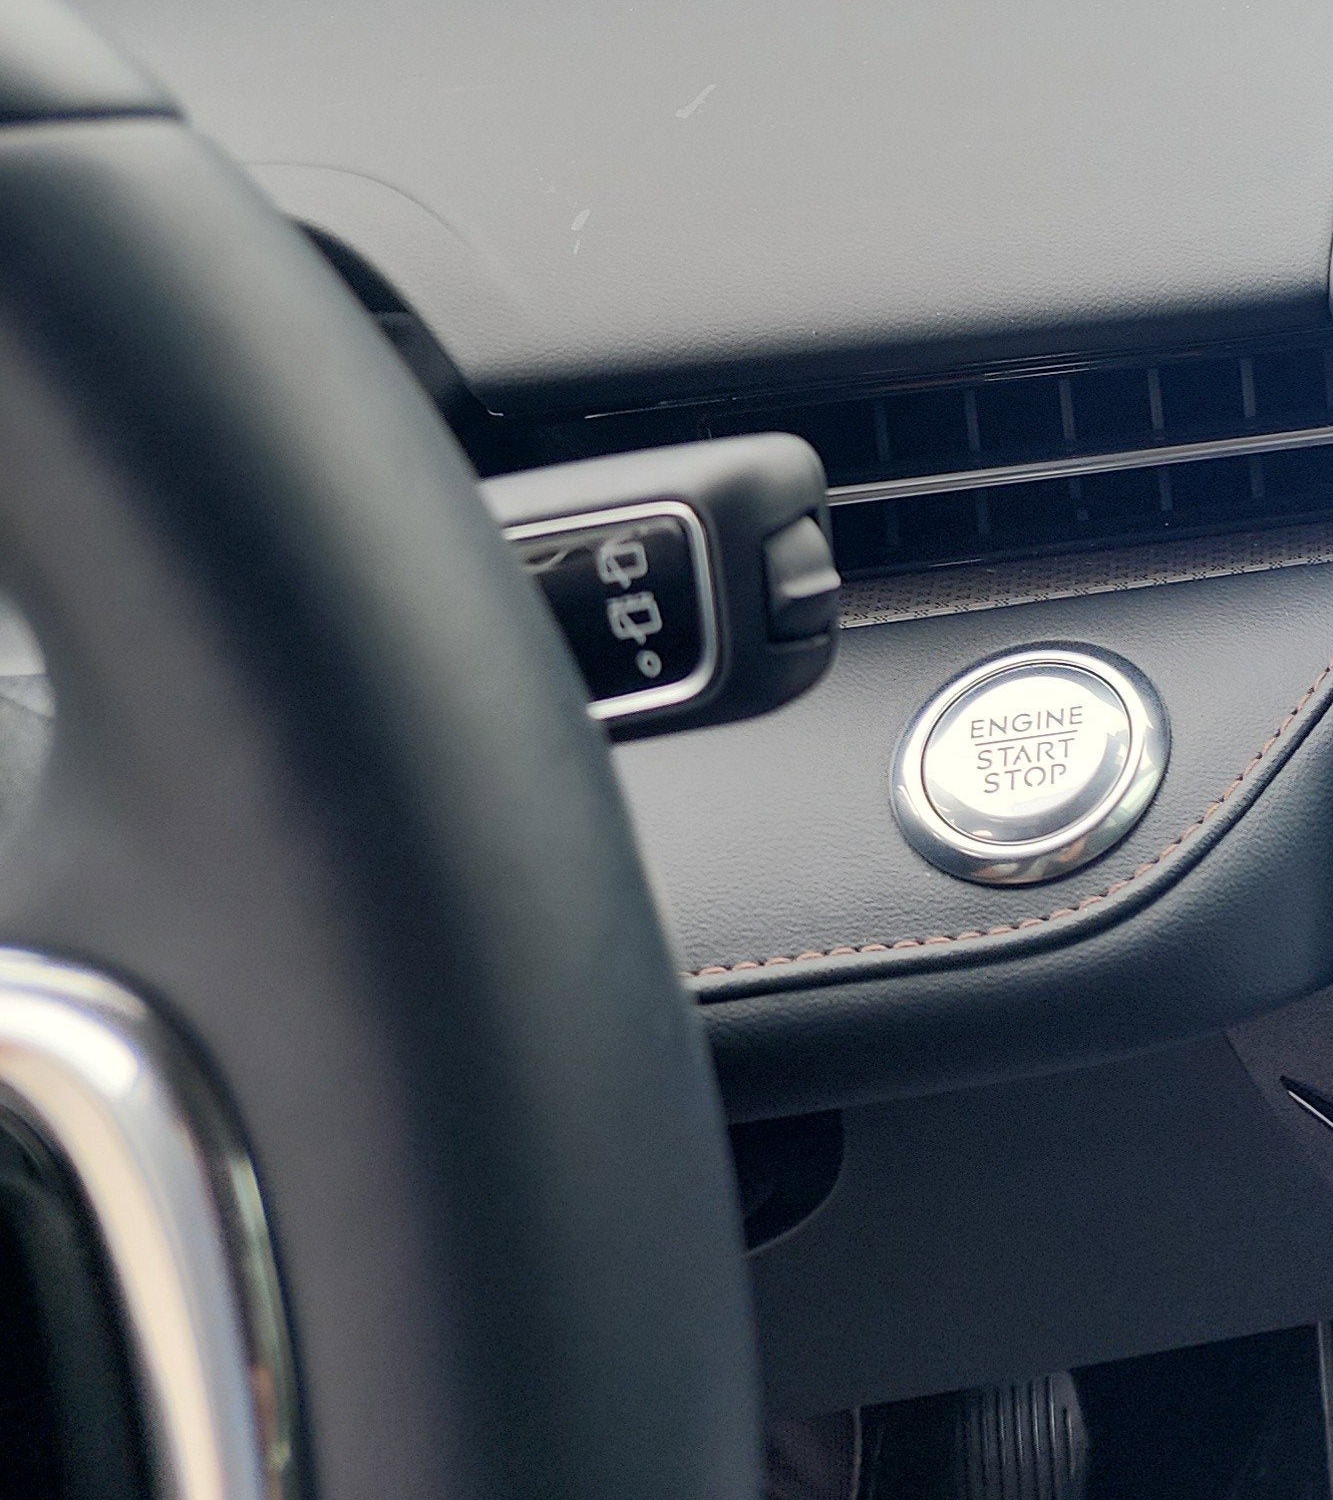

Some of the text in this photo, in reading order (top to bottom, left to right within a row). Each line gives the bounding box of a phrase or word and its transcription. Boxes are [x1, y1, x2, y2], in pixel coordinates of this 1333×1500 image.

[969, 706, 1084, 739] ENGINE
[976, 737, 1076, 771] START
[982, 763, 1068, 794] STOP
